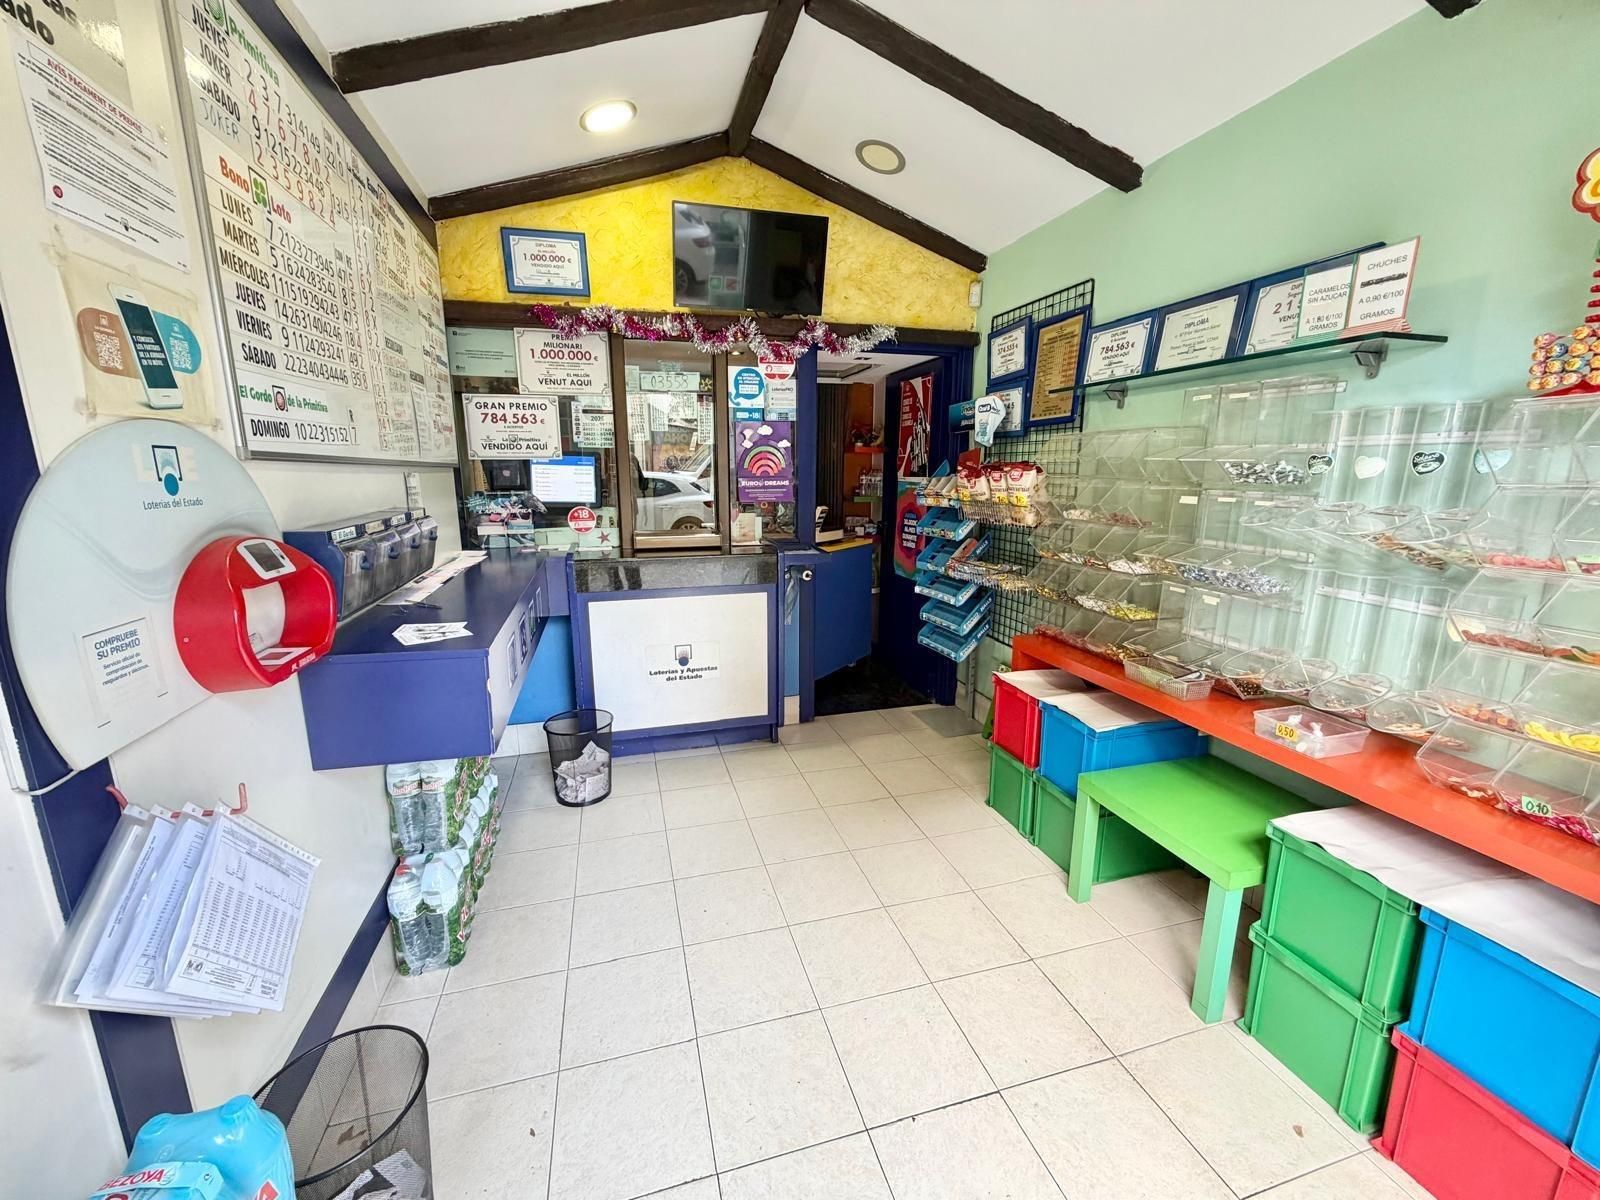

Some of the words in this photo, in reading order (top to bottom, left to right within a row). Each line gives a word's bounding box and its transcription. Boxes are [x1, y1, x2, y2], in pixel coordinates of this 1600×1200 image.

[192, 4, 230, 59] JUEVES
[244, 58, 254, 87] 2
[260, 75, 269, 102] 3
[274, 91, 280, 113] 7
[228, 16, 280, 88] Primitiva
[47, 58, 68, 78] AVIS
[67, 72, 107, 107] PAGAMENT
[107, 103, 118, 115] DE
[117, 110, 143, 133] PREMIS
[200, 38, 232, 87] JOKER
[249, 89, 258, 113] 4
[278, 118, 285, 141] 6
[303, 143, 310, 165] 8
[252, 114, 261, 140] 9
[200, 97, 240, 143] JOKER
[255, 141, 264, 167] 2
[270, 155, 279, 180] 3
[284, 168, 291, 190] 5
[297, 180, 304, 201] 9
[308, 190, 315, 211] 8
[219, 155, 250, 193] Bono
[270, 195, 292, 224] Loto
[220, 188, 253, 226] LUNES
[266, 217, 273, 241] 7
[222, 217, 259, 256] MARTES
[270, 246, 278, 268] 5
[342, 287, 348, 305] 8
[523, 252, 566, 264] 1.000.000
[1367, 254, 1408, 271] CHUCHES
[219, 246, 270, 290] MIÉRCOLES
[236, 281, 266, 312] JUEVES
[1308, 282, 1351, 297] CARAMELOS
[1319, 290, 1348, 302] AZUCAR
[1383, 289, 1404, 300] €/100
[1360, 308, 1395, 320] GRAMOS
[236, 309, 272, 340] VIERNES
[281, 326, 289, 348] 9
[1184, 317, 1209, 329] DIPLOMA
[1308, 321, 1338, 332] GRAMOS
[543, 341, 583, 350] MILIONARI
[1100, 341, 1130, 355] 784.563
[241, 341, 277, 370] SÁBADO
[529, 348, 592, 361] 1.000.000
[538, 377, 566, 386] VENUT
[239, 385, 248, 399] El
[249, 387, 273, 403] Gordo
[287, 394, 296, 407] de
[296, 397, 303, 409] la
[303, 398, 328, 413] Primitiva
[474, 401, 506, 410] GRAN
[509, 402, 548, 411] PREMIO
[480, 412, 538, 425] 784.563
[250, 419, 290, 438] DOMINGO
[481, 443, 522, 451] VENDIDO
[525, 442, 548, 451] AQUÍ
[172, 498, 183, 508] del
[183, 497, 204, 507] Estado
[94, 629, 139, 650] COMPRUEBE
[96, 649, 109, 660] SU
[110, 637, 141, 655] PREMIO
[103, 659, 121, 670] Servicio
[122, 653, 134, 662] oficial
[686, 665, 718, 673] Apuestas
[102, 672, 128, 686] resguardos
[97, 1168, 165, 1191] BEZOYA
